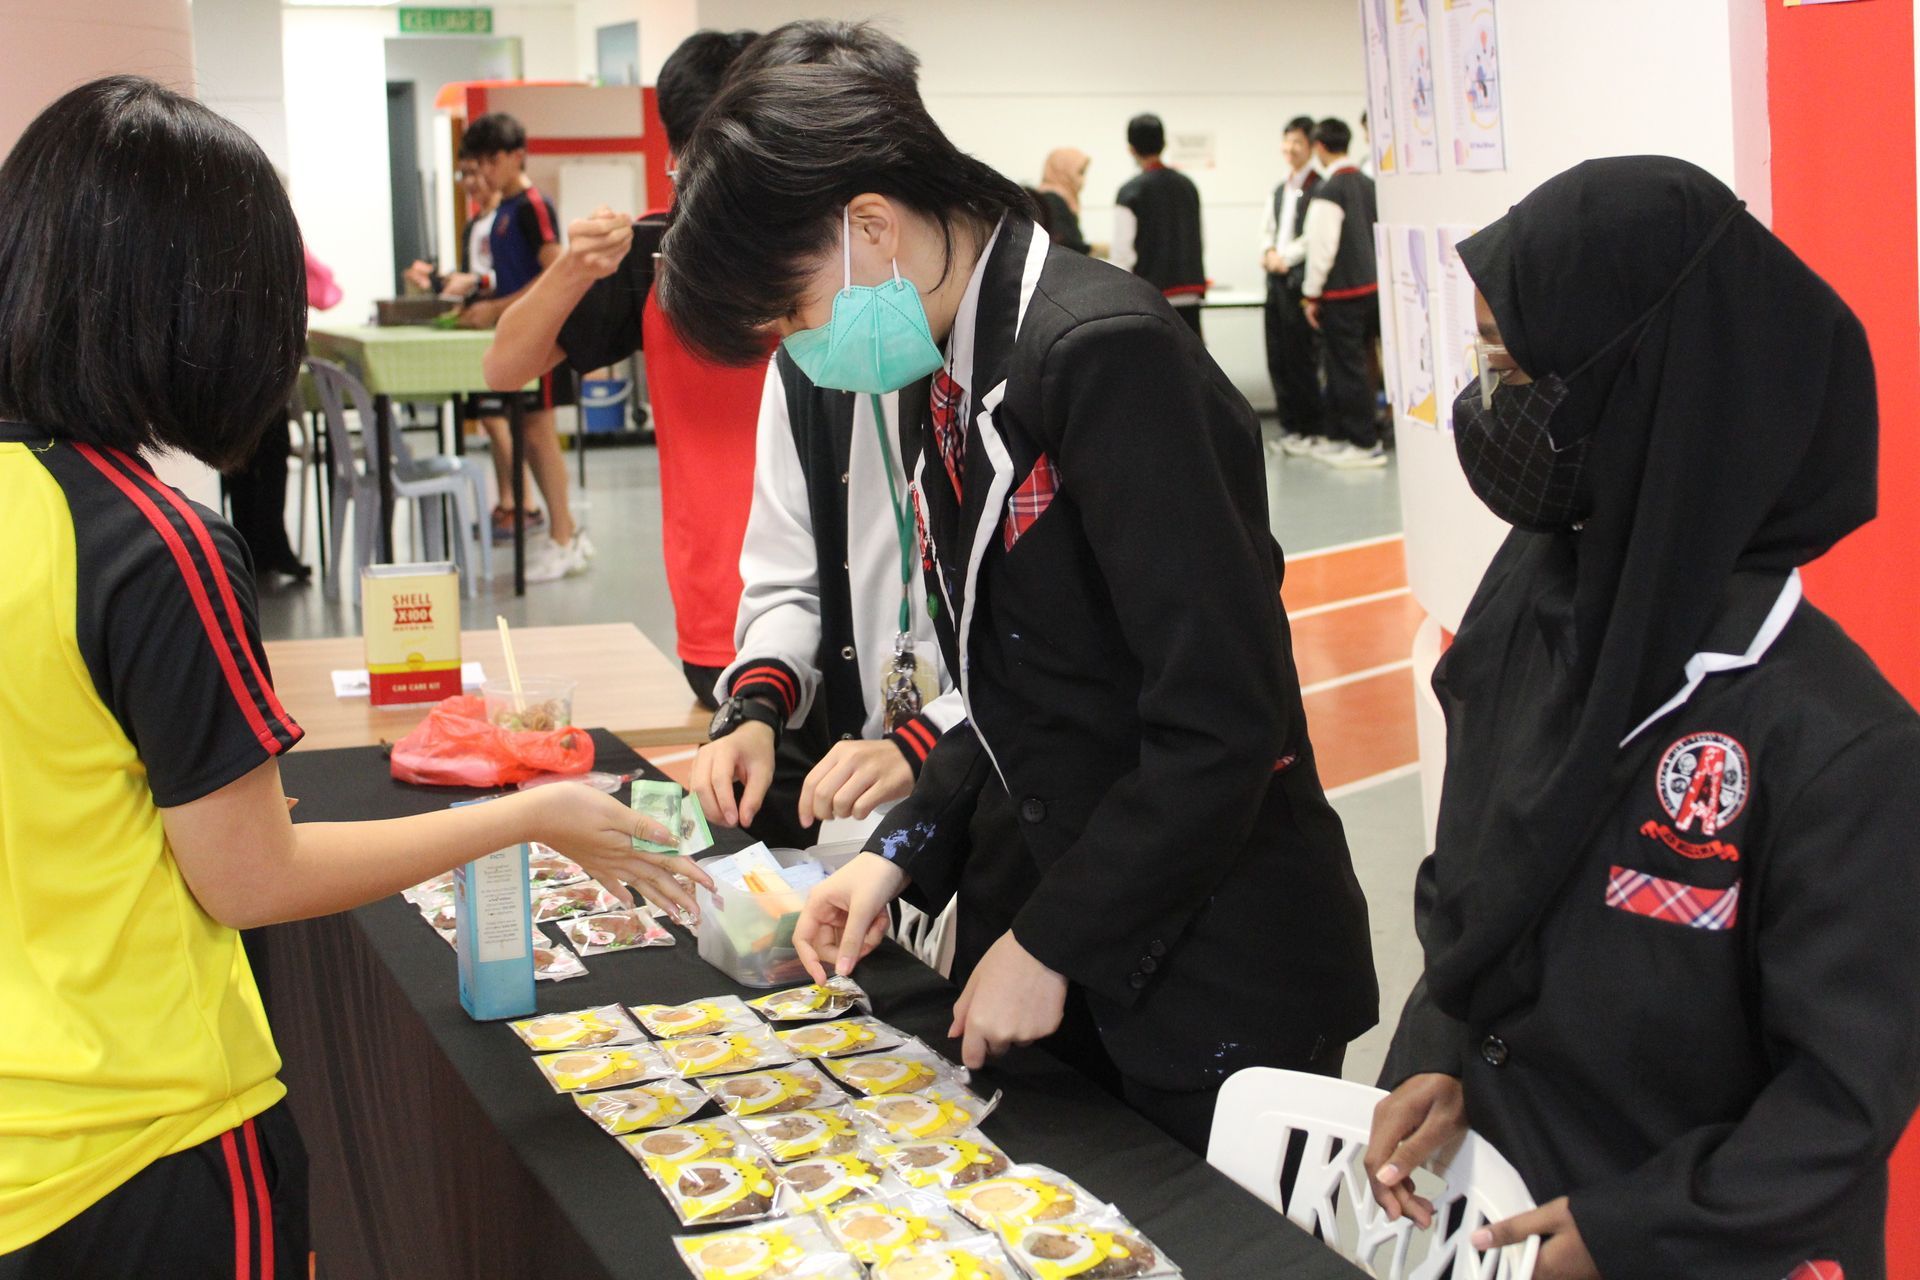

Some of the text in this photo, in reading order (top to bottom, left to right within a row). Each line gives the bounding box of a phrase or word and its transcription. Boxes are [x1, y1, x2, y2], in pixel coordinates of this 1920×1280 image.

[393, 594, 431, 606] SHELL
[392, 682, 441, 692] CAR CARE KIT
